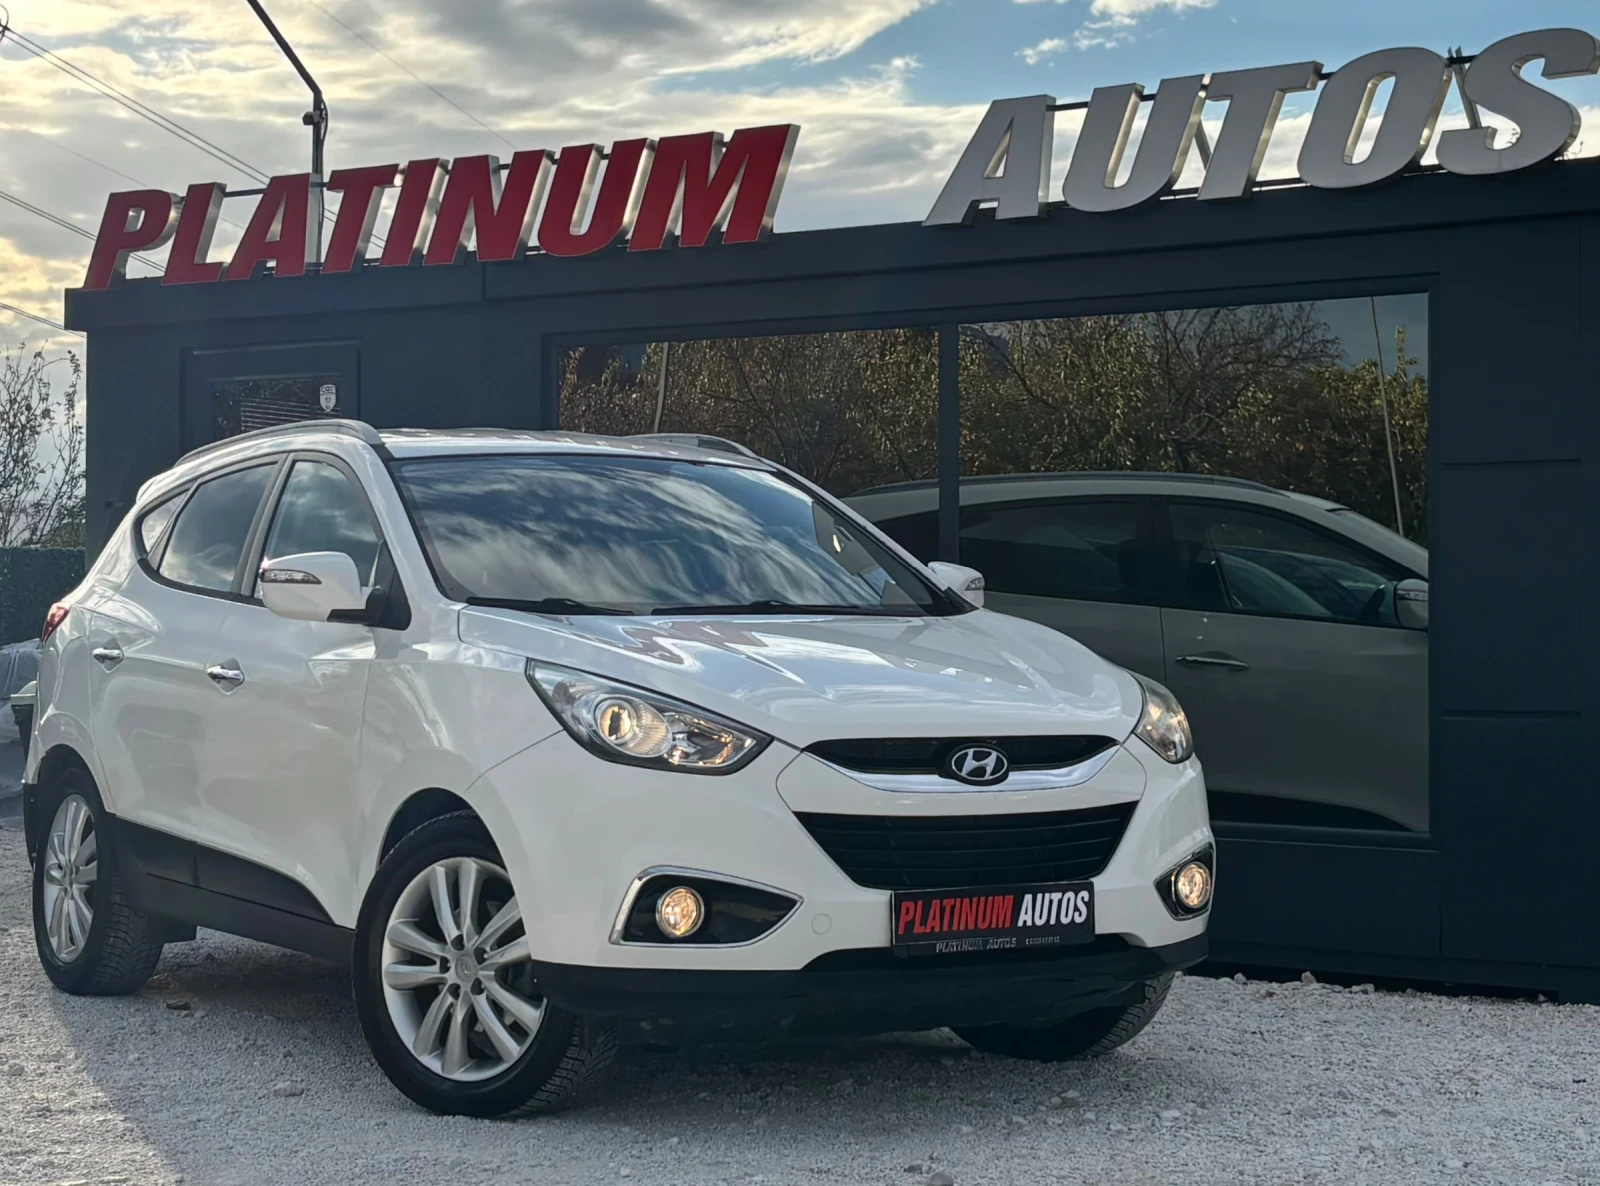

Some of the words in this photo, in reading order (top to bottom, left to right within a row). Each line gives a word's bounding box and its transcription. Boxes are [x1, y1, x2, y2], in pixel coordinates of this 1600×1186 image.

[83, 124, 800, 291] PLATINUM
[922, 28, 1600, 227] AUTOS
[898, 895, 1014, 934] PLATINUM
[1017, 890, 1090, 927] AUTOS
[986, 937, 1017, 949] AUTOS
